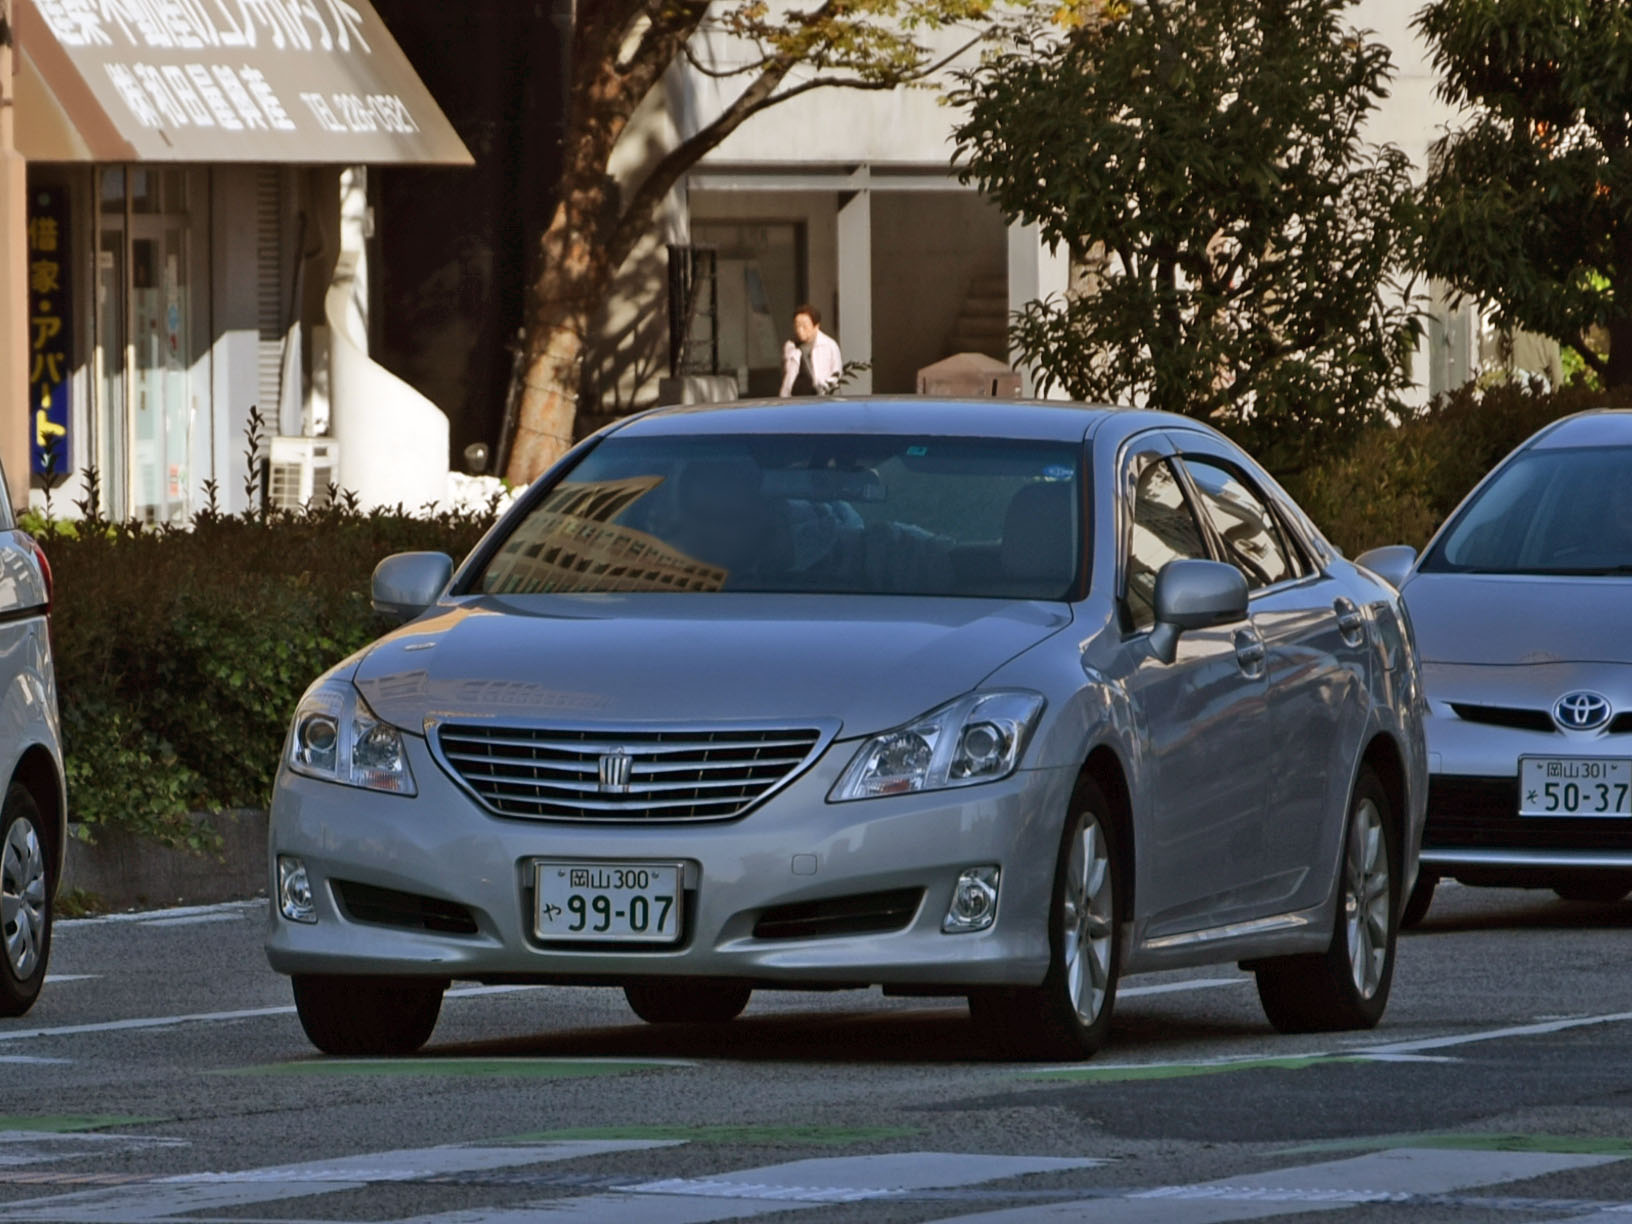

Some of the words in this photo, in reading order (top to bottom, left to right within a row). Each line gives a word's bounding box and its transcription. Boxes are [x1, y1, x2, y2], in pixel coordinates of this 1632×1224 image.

[299, 92, 348, 132] TEL
[1544, 782, 1629, 813] 50-37
[567, 894, 674, 933] 99-07
